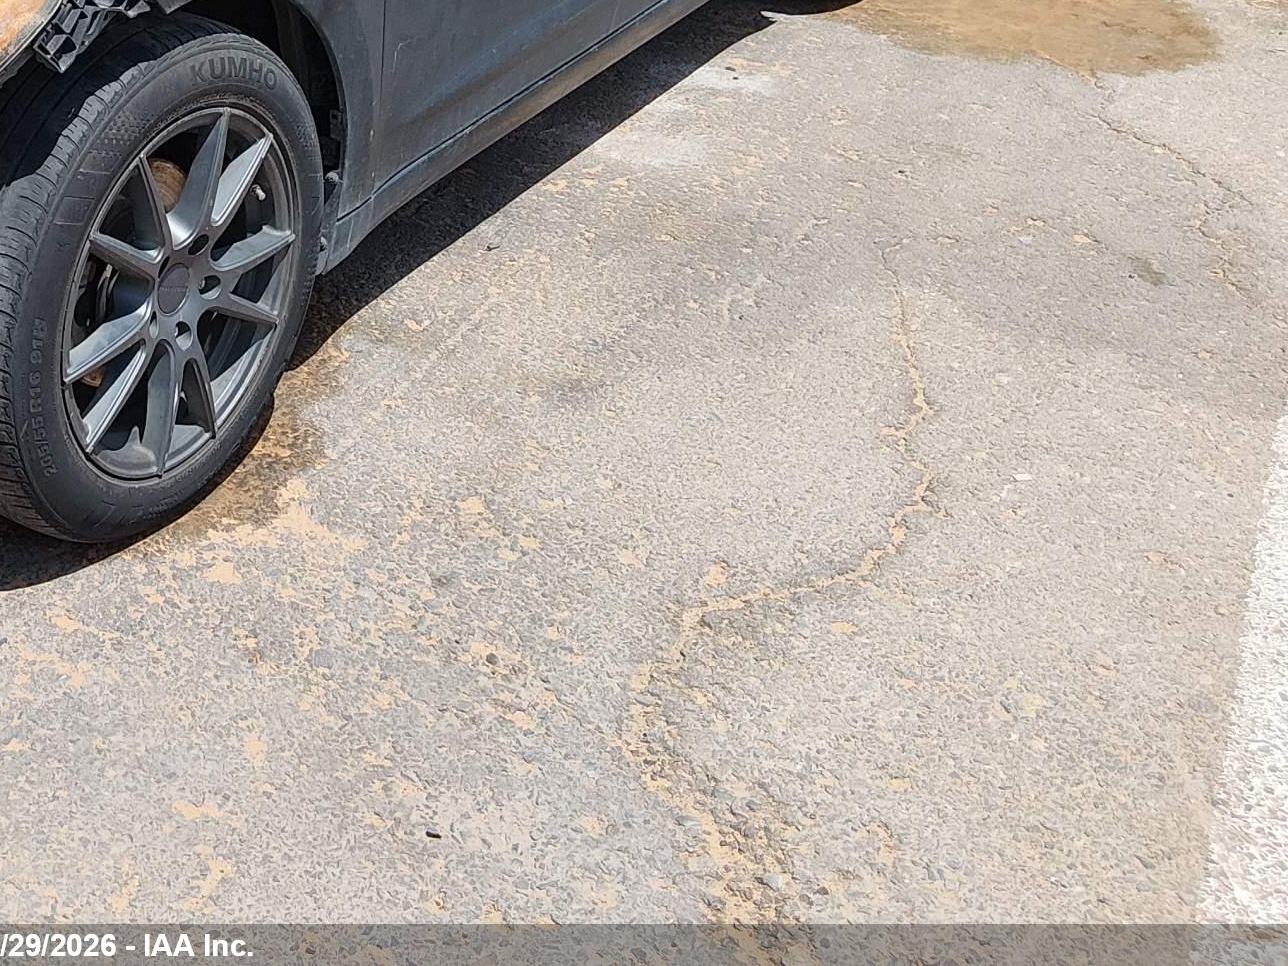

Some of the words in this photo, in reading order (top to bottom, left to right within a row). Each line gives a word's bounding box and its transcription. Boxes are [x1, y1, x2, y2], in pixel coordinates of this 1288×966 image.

[189, 56, 277, 90] KUMHO
[29, 371, 43, 414] R16
[30, 416, 58, 477] 205/55
